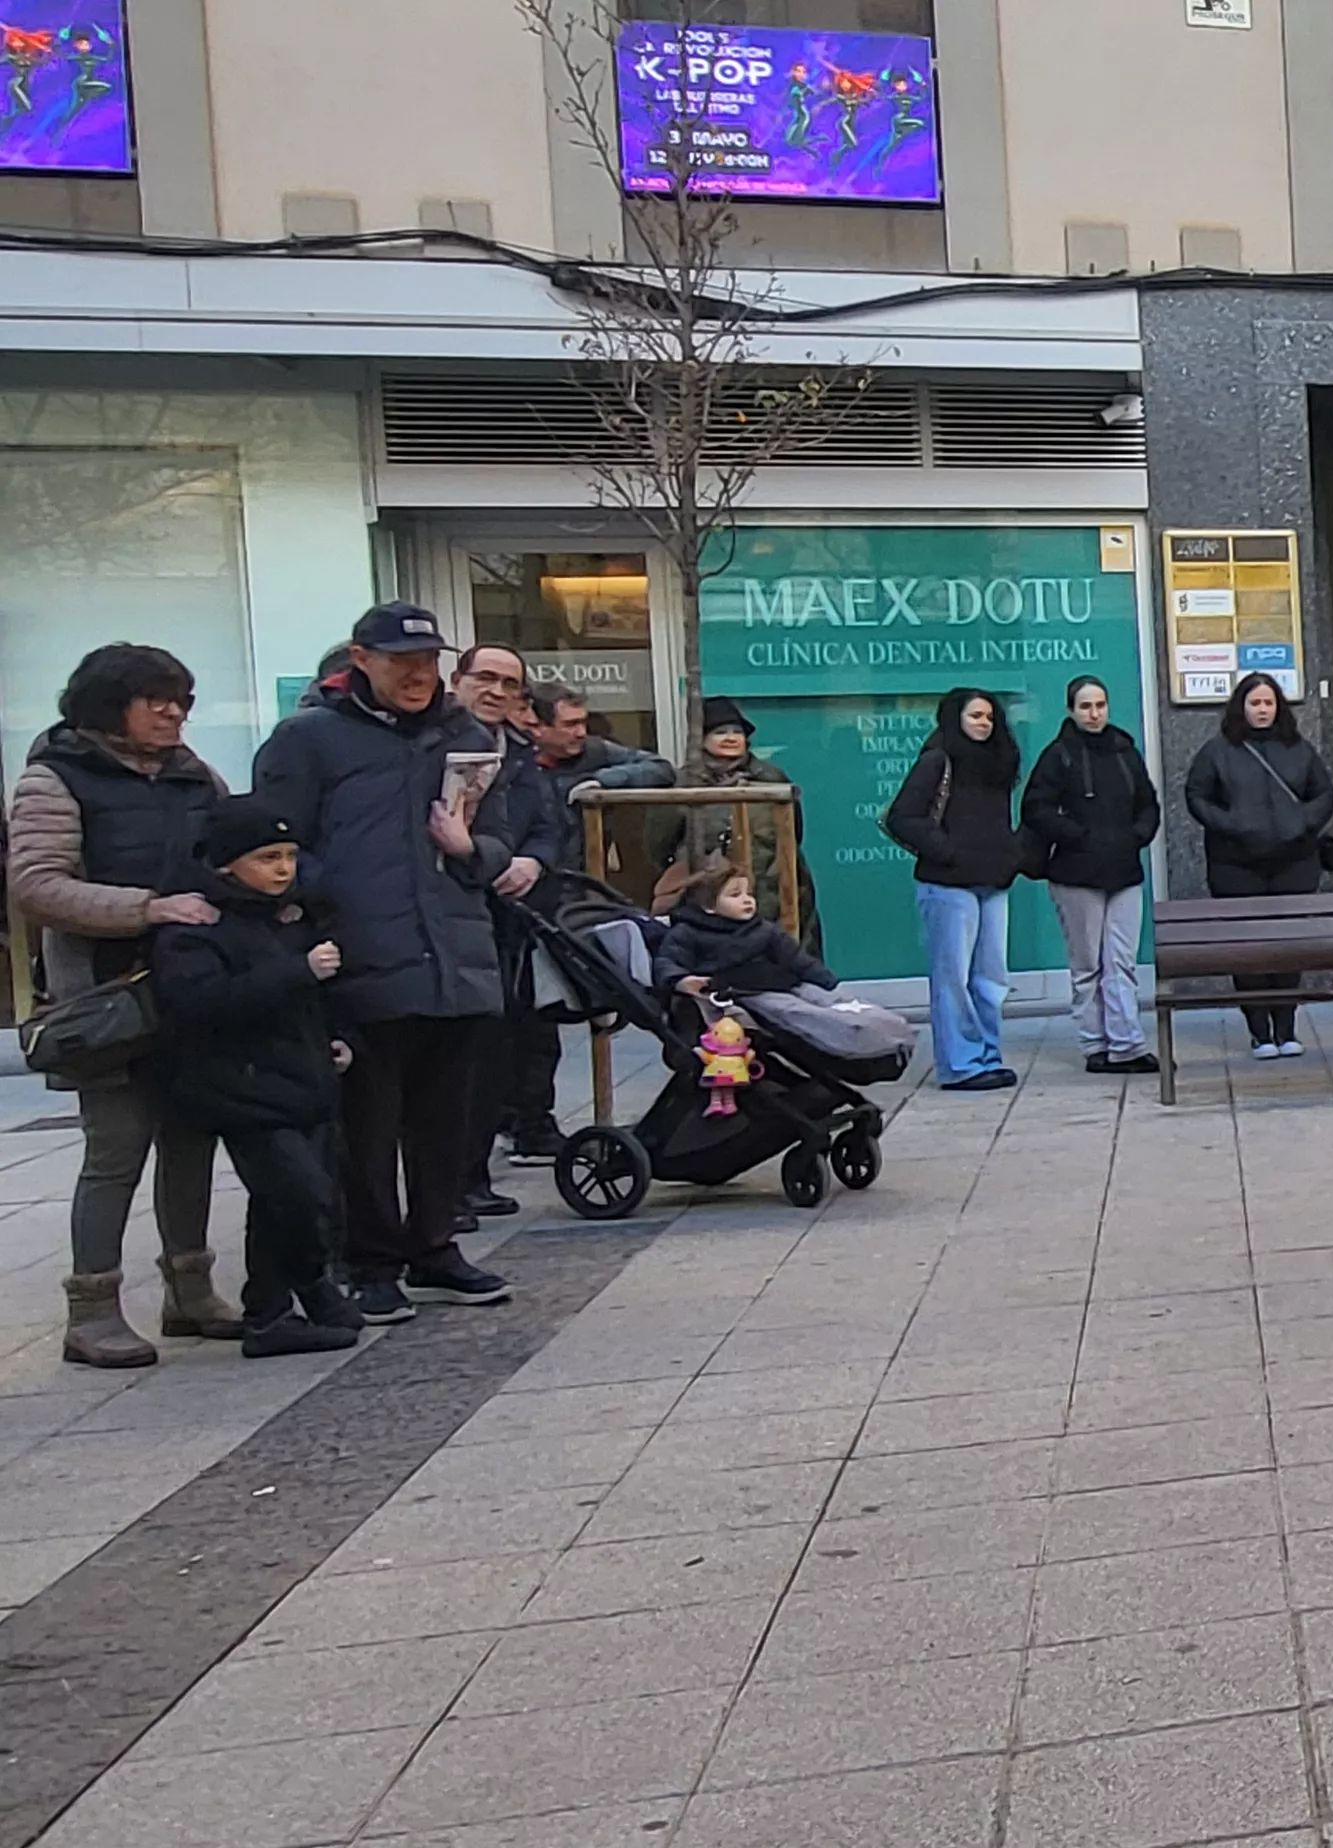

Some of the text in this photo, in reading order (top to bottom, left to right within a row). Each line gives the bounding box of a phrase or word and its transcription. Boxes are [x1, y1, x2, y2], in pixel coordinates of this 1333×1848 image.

[743, 577, 1095, 628] MAEX DOTU
[746, 637, 1098, 667] CLÍNICA DENTAL INTEGRAL
[573, 661, 628, 682] DOTU
